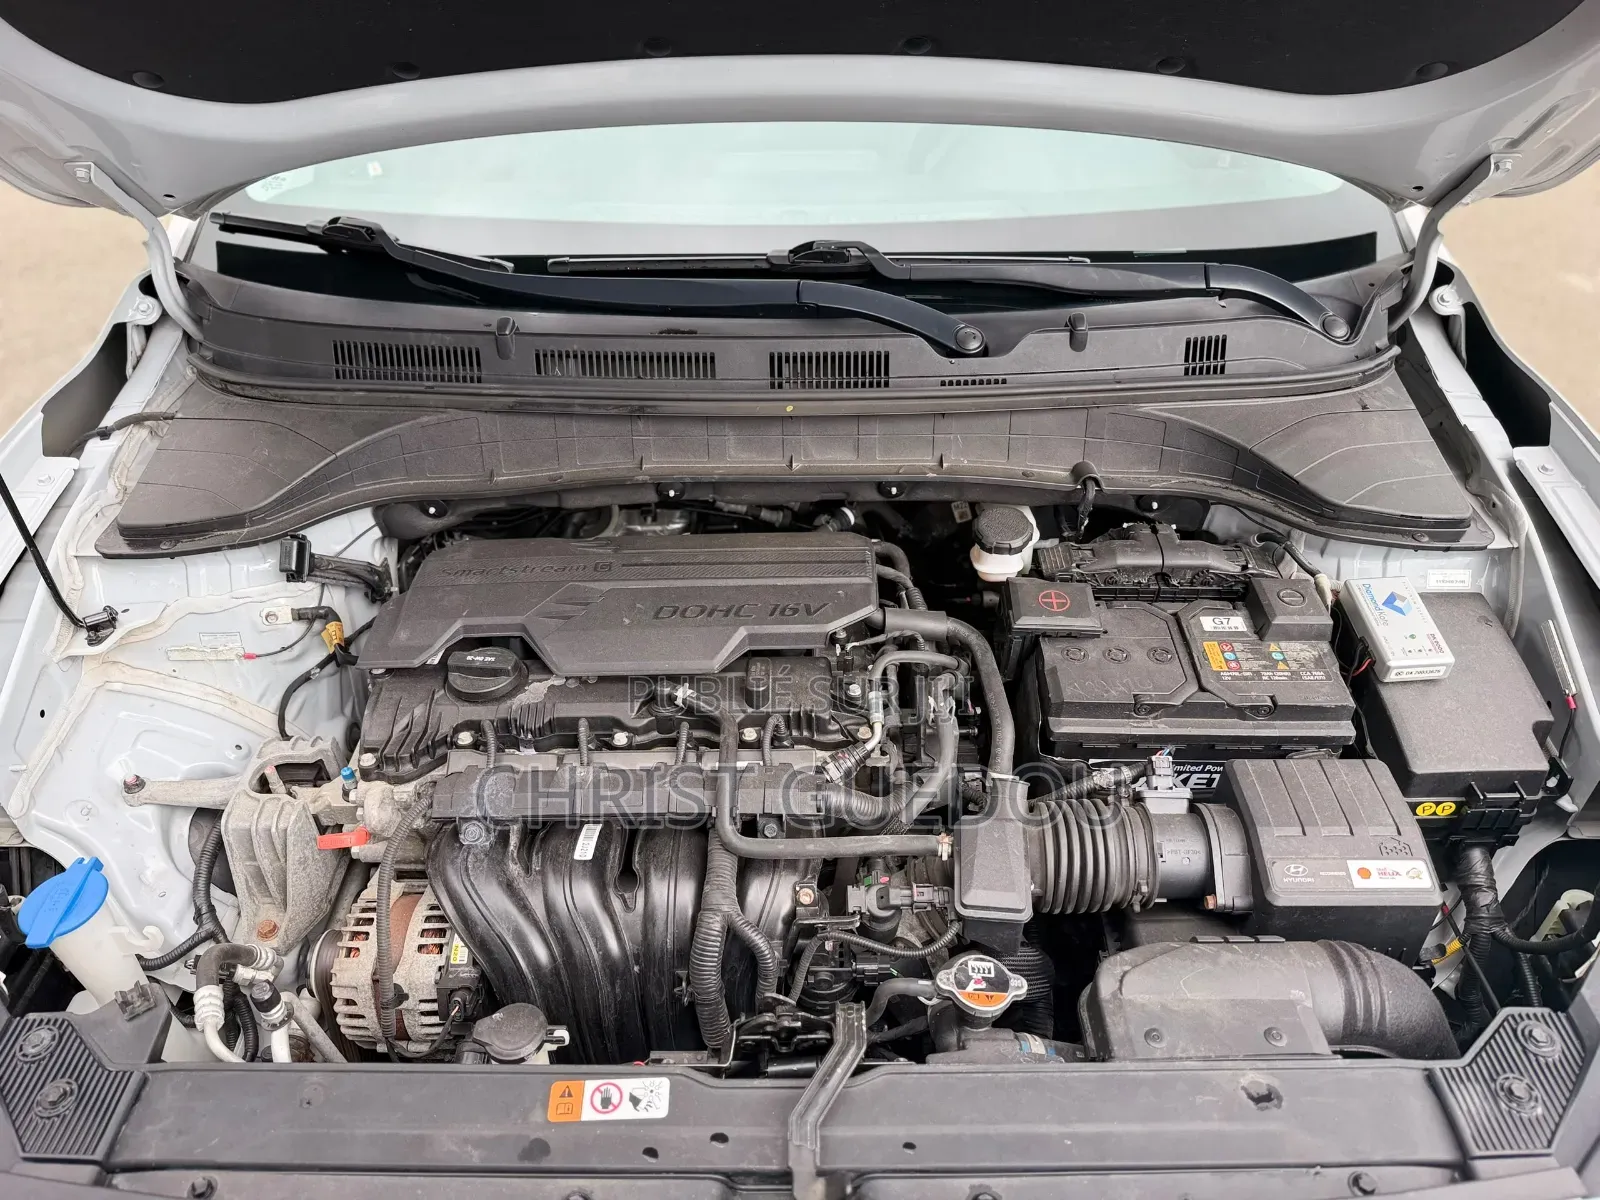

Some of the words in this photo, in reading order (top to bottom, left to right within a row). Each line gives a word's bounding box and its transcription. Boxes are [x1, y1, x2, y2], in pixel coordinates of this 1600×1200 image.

[652, 603, 762, 620] DOHC
[767, 601, 832, 618] 16V
[1212, 617, 1231, 626] G7
